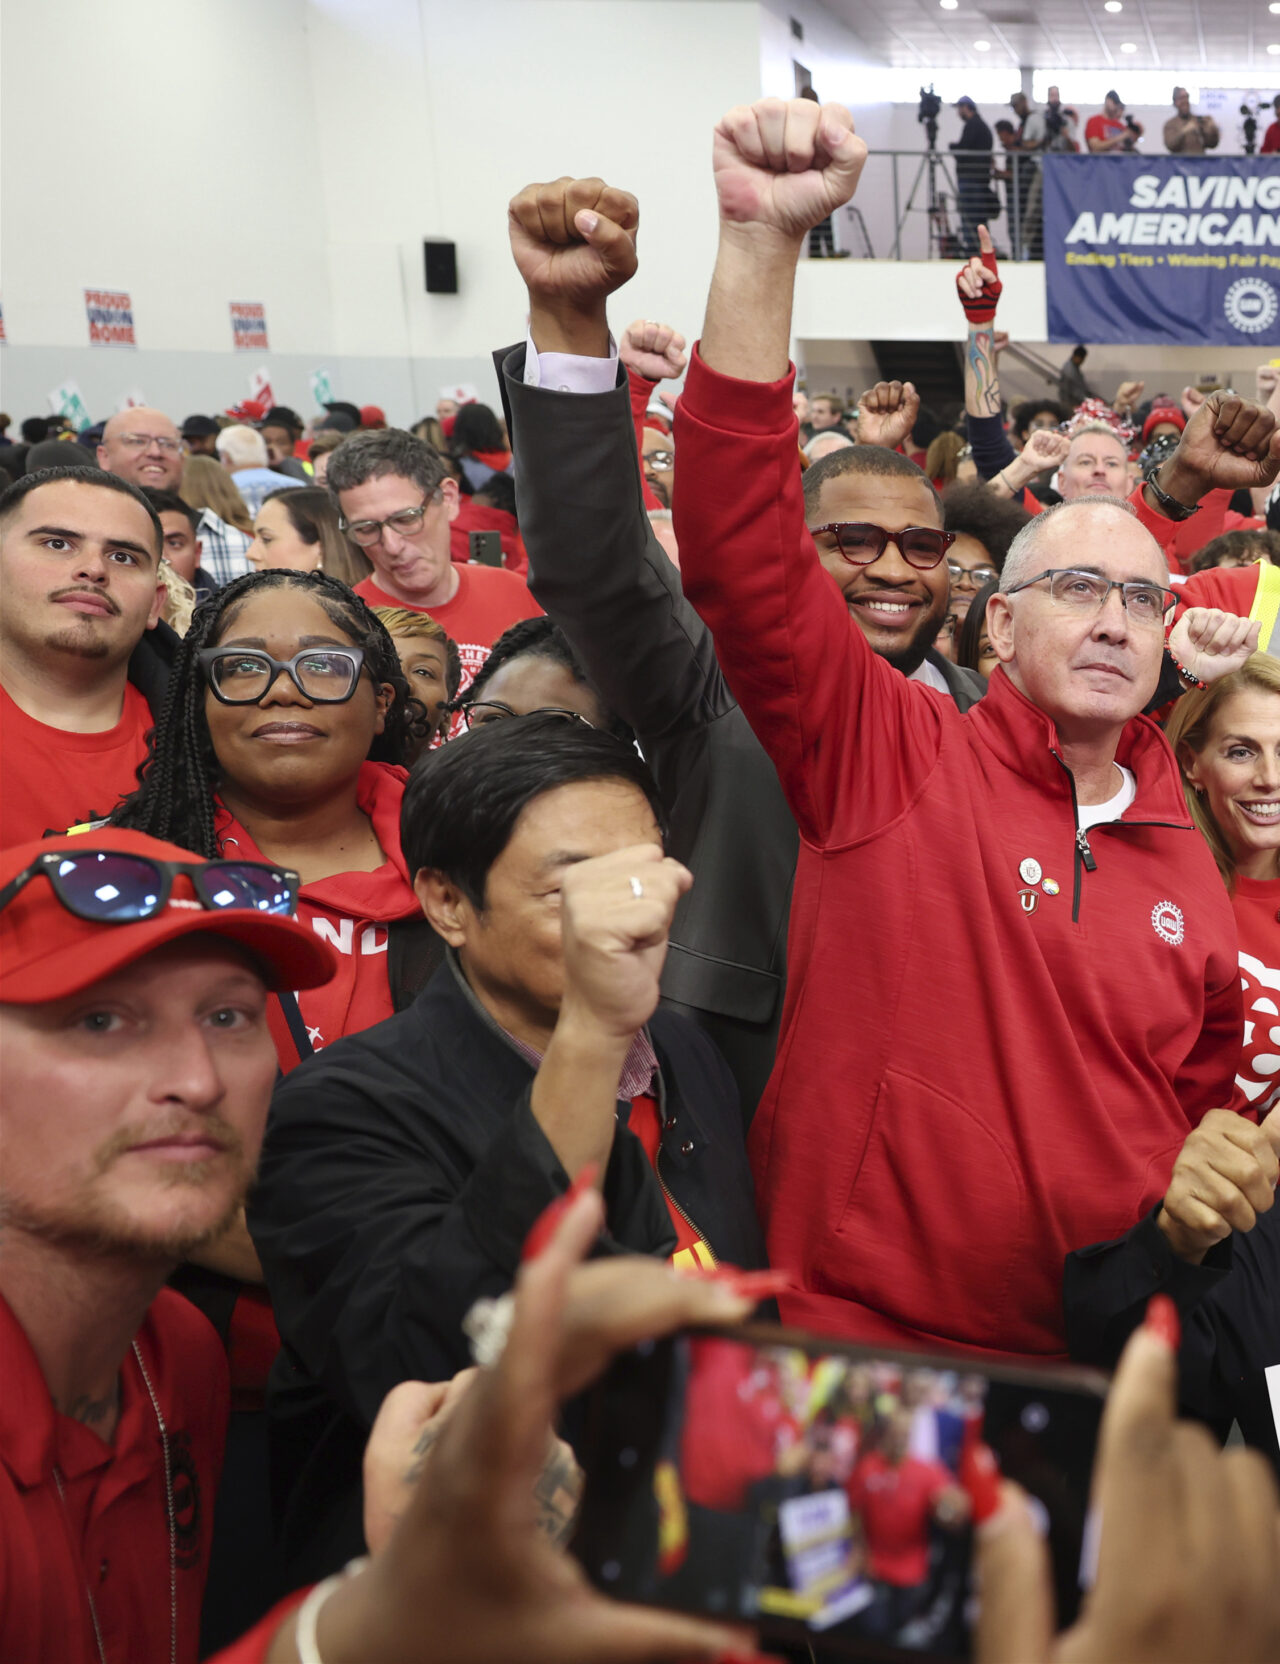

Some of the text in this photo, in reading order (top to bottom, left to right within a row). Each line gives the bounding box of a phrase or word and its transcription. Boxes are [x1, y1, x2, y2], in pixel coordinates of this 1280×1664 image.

[1065, 252, 1116, 268] Ending
[1119, 253, 1154, 266] Tiers
[1167, 254, 1227, 269] Winning
[1229, 254, 1256, 267] Fair
[1160, 915, 1178, 932] UAW
